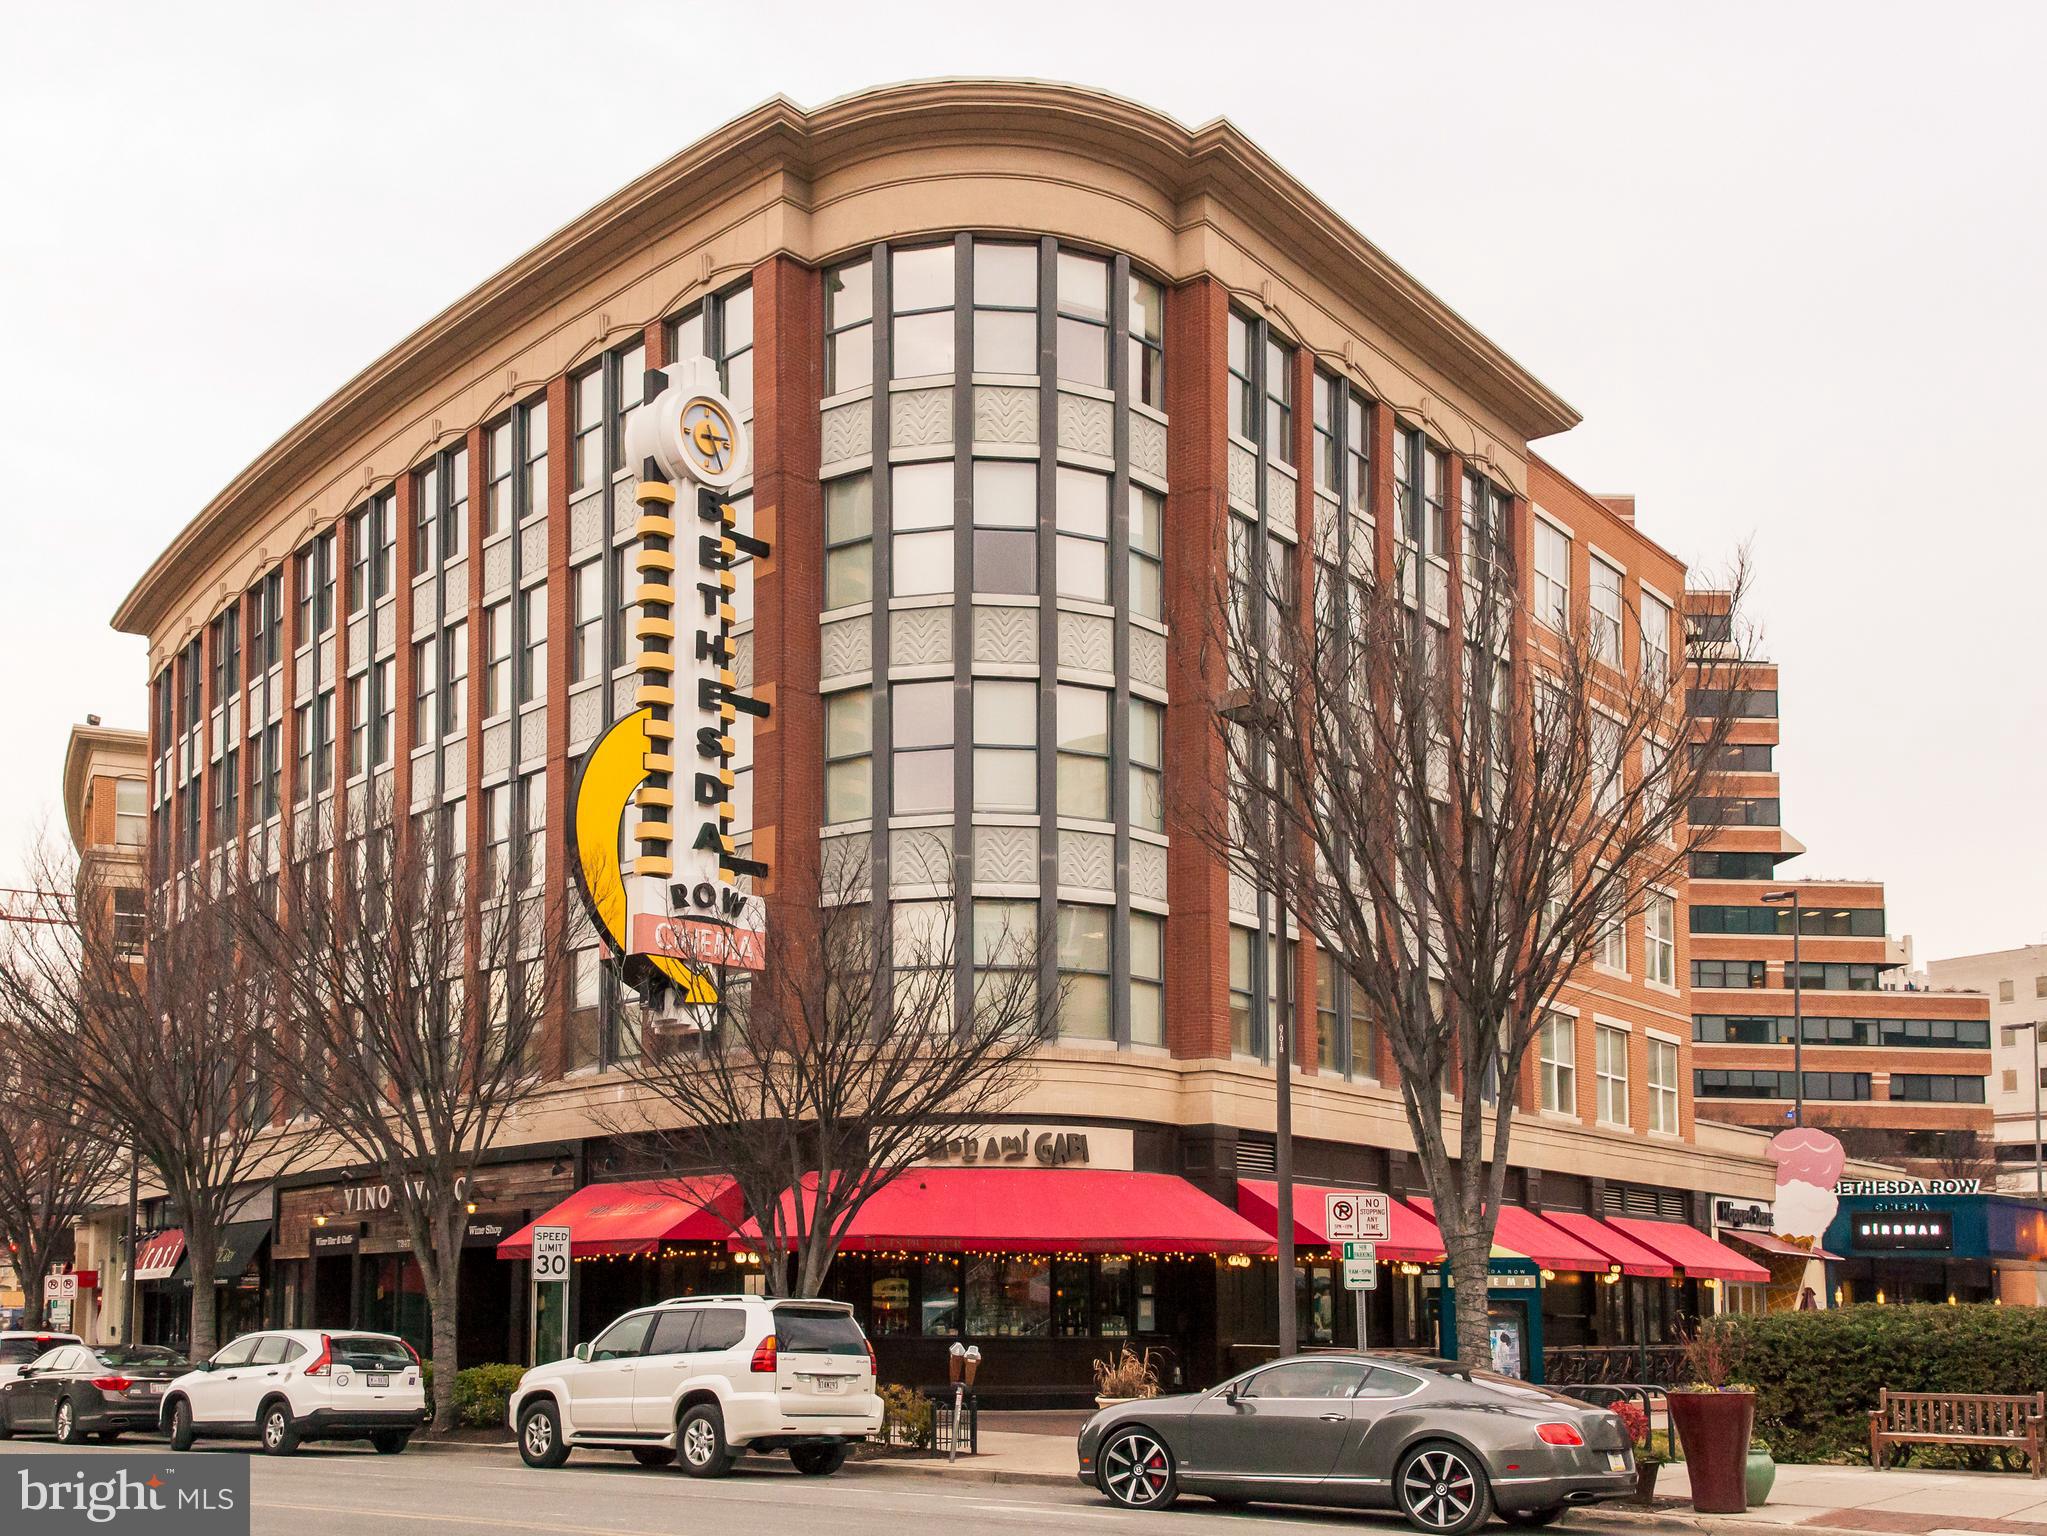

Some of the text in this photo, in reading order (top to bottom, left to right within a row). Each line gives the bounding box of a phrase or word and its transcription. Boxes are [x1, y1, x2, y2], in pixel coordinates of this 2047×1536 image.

[692, 486, 729, 852] BETHESDA
[669, 883, 748, 919] ROW
[655, 922, 756, 962] CINEMA
[1930, 1179, 1980, 1194] ROW
[344, 1184, 391, 1211] VINO
[1365, 1199, 1380, 1208] NO
[1359, 1208, 1386, 1216] STOPPING
[485, 1224, 502, 1237] Shop
[536, 1232, 568, 1241] SPEED
[540, 1243, 563, 1252] LIMIT
[1347, 1245, 1351, 1258] 1
[536, 1254, 566, 1275] 30
